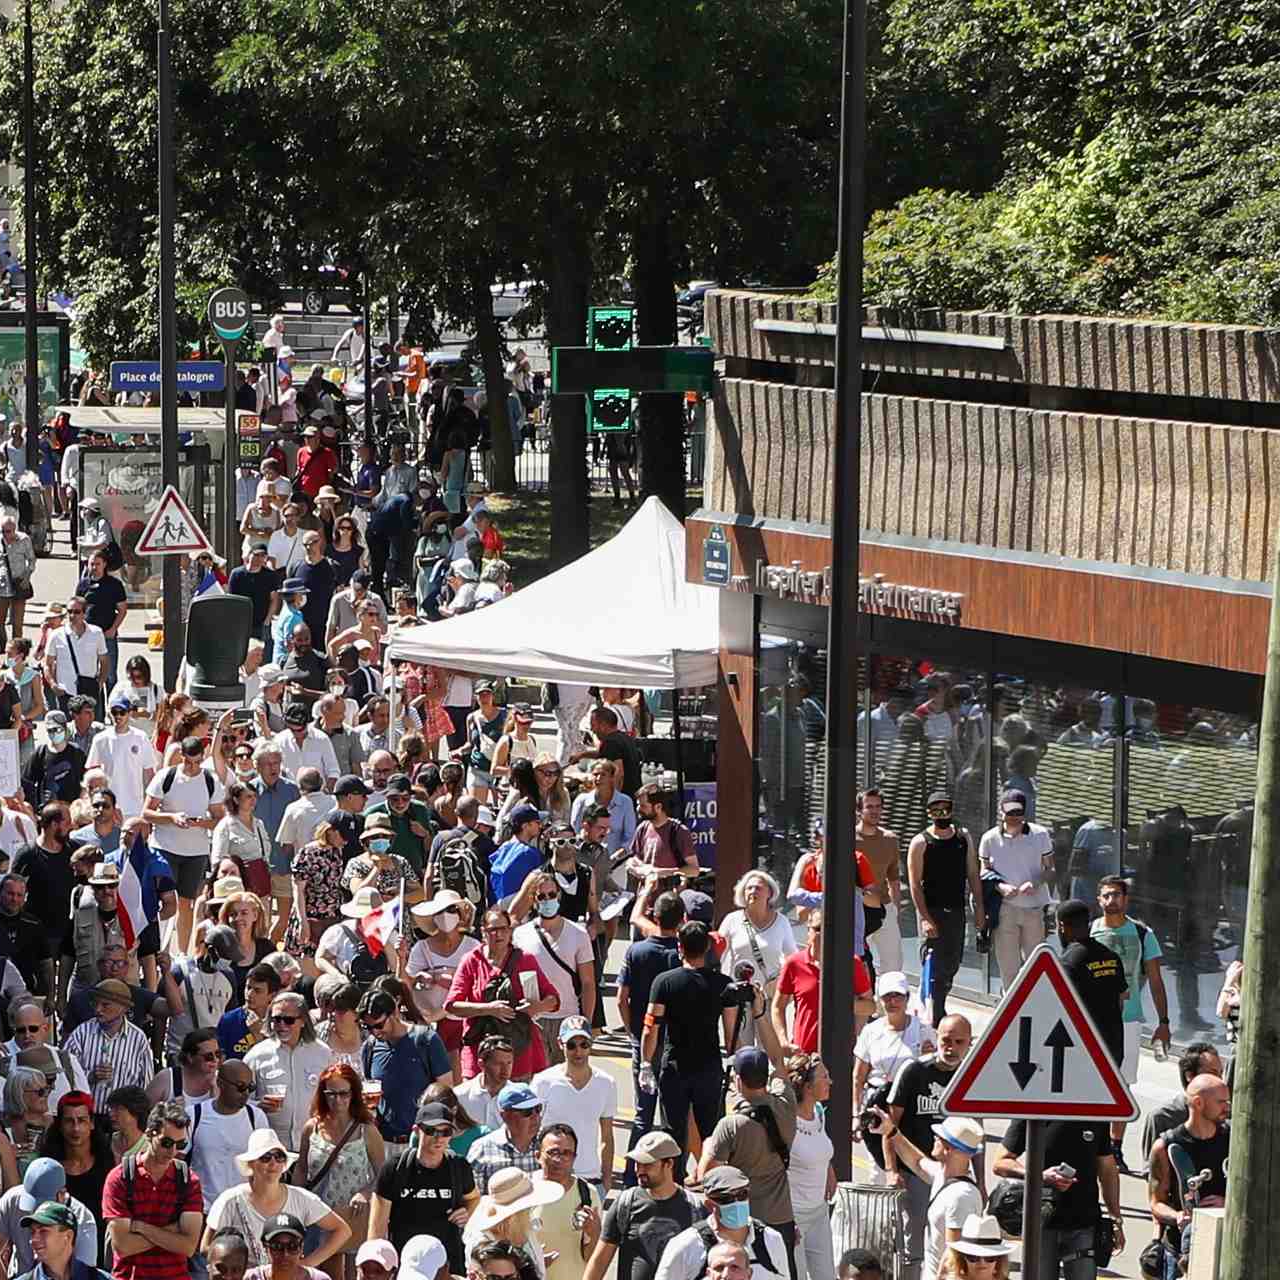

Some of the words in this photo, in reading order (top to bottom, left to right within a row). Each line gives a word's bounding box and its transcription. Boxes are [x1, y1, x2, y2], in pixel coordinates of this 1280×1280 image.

[215, 302, 247, 318] BUS
[120, 372, 147, 382] Place
[177, 372, 215, 384] talogne
[242, 443, 258, 456] 88
[691, 828, 716, 844] ent
